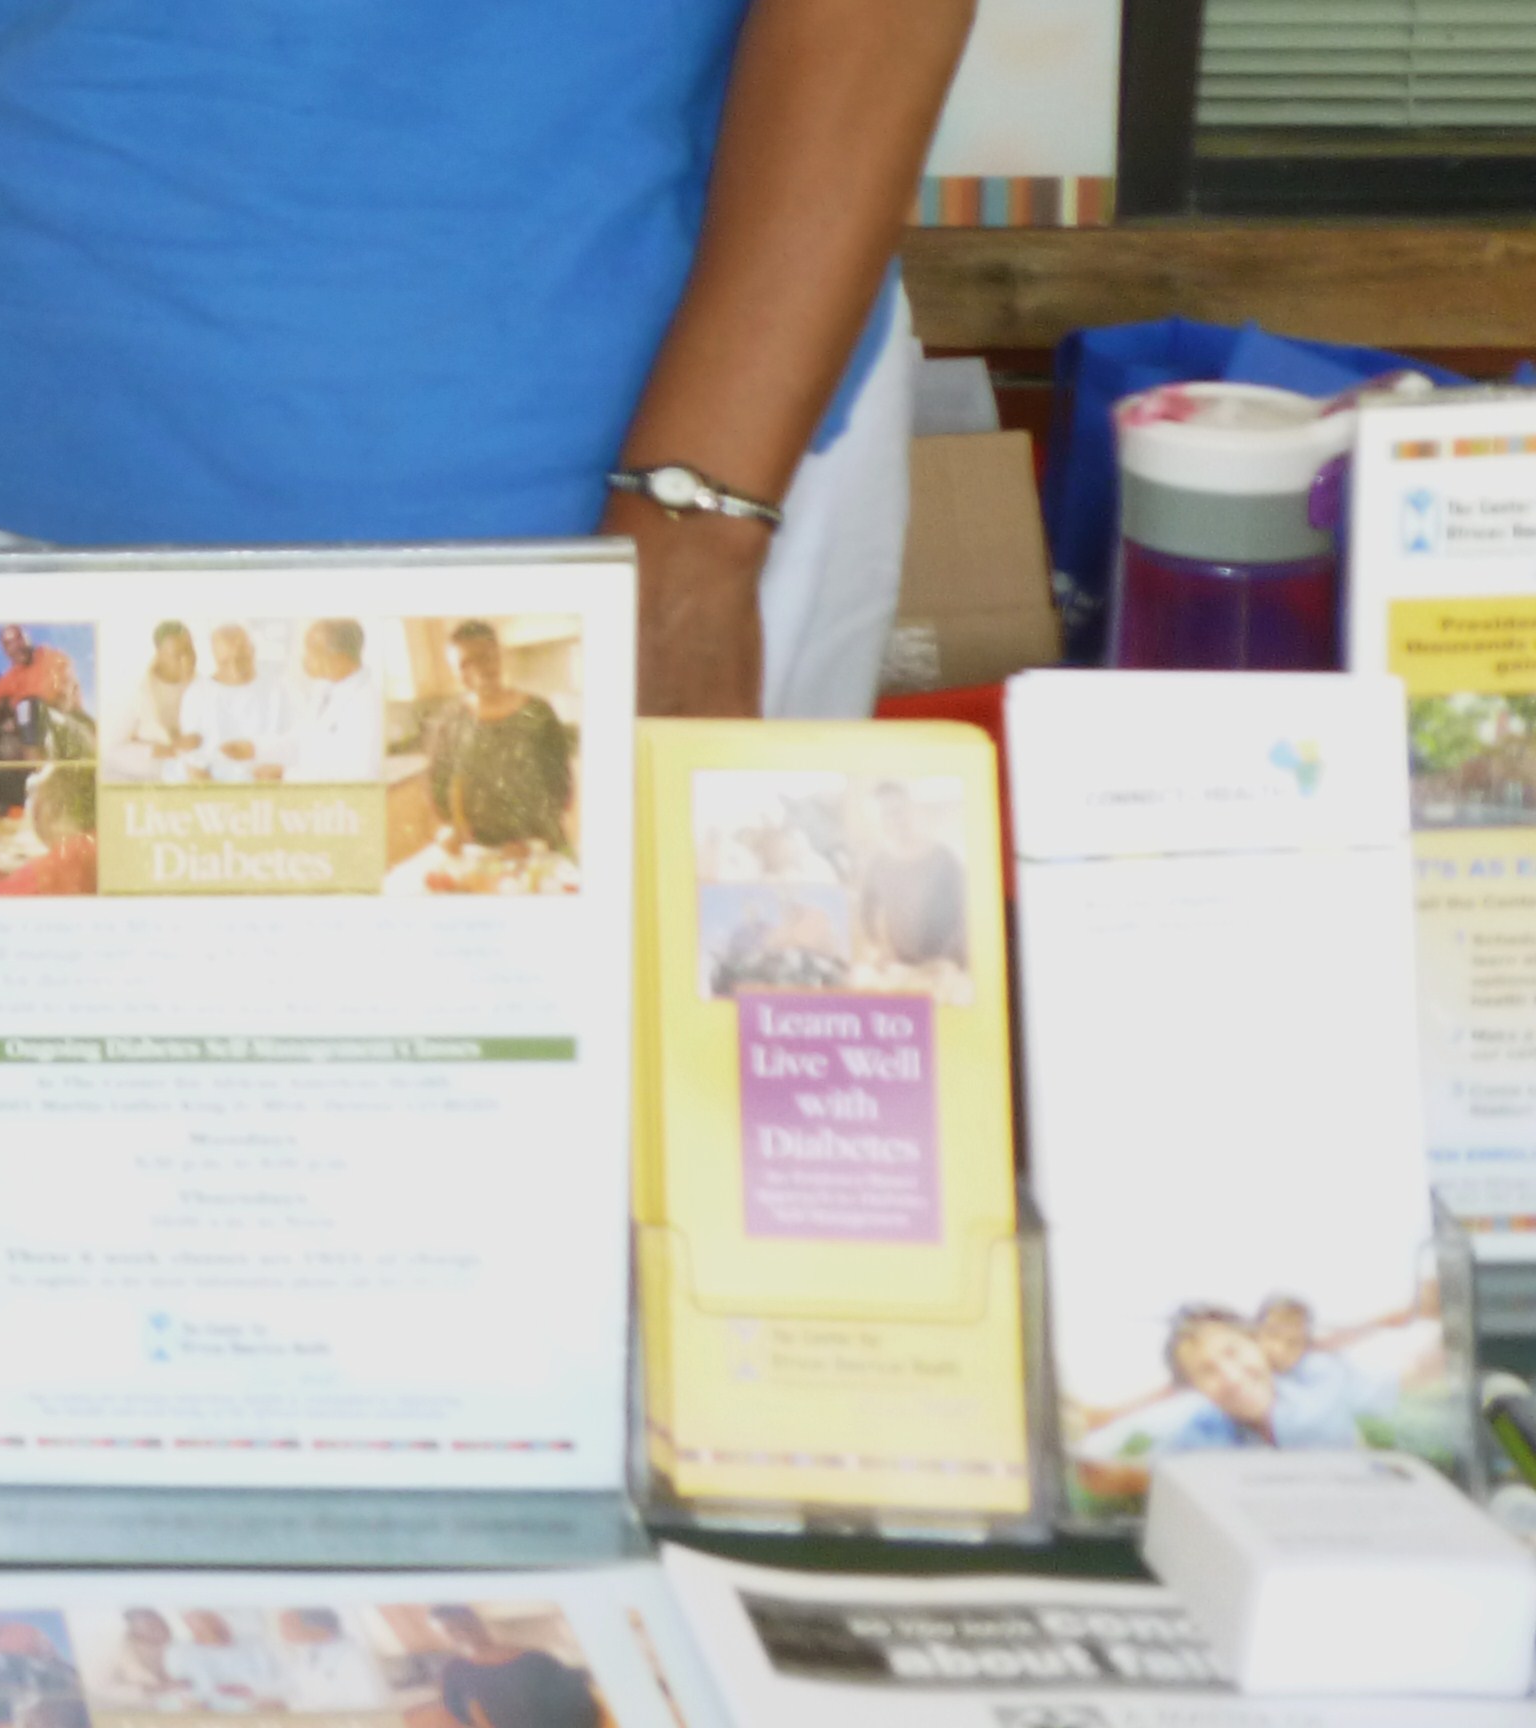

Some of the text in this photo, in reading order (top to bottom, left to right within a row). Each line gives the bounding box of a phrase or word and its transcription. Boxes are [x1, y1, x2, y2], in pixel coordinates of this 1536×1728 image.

[123, 798, 360, 840] Live Well with
[150, 841, 334, 881] Diabetes
[757, 1003, 914, 1042] Learn to
[751, 1044, 923, 1085] Live Well
[793, 1086, 880, 1124] with
[756, 1126, 922, 1165] Diabetes
